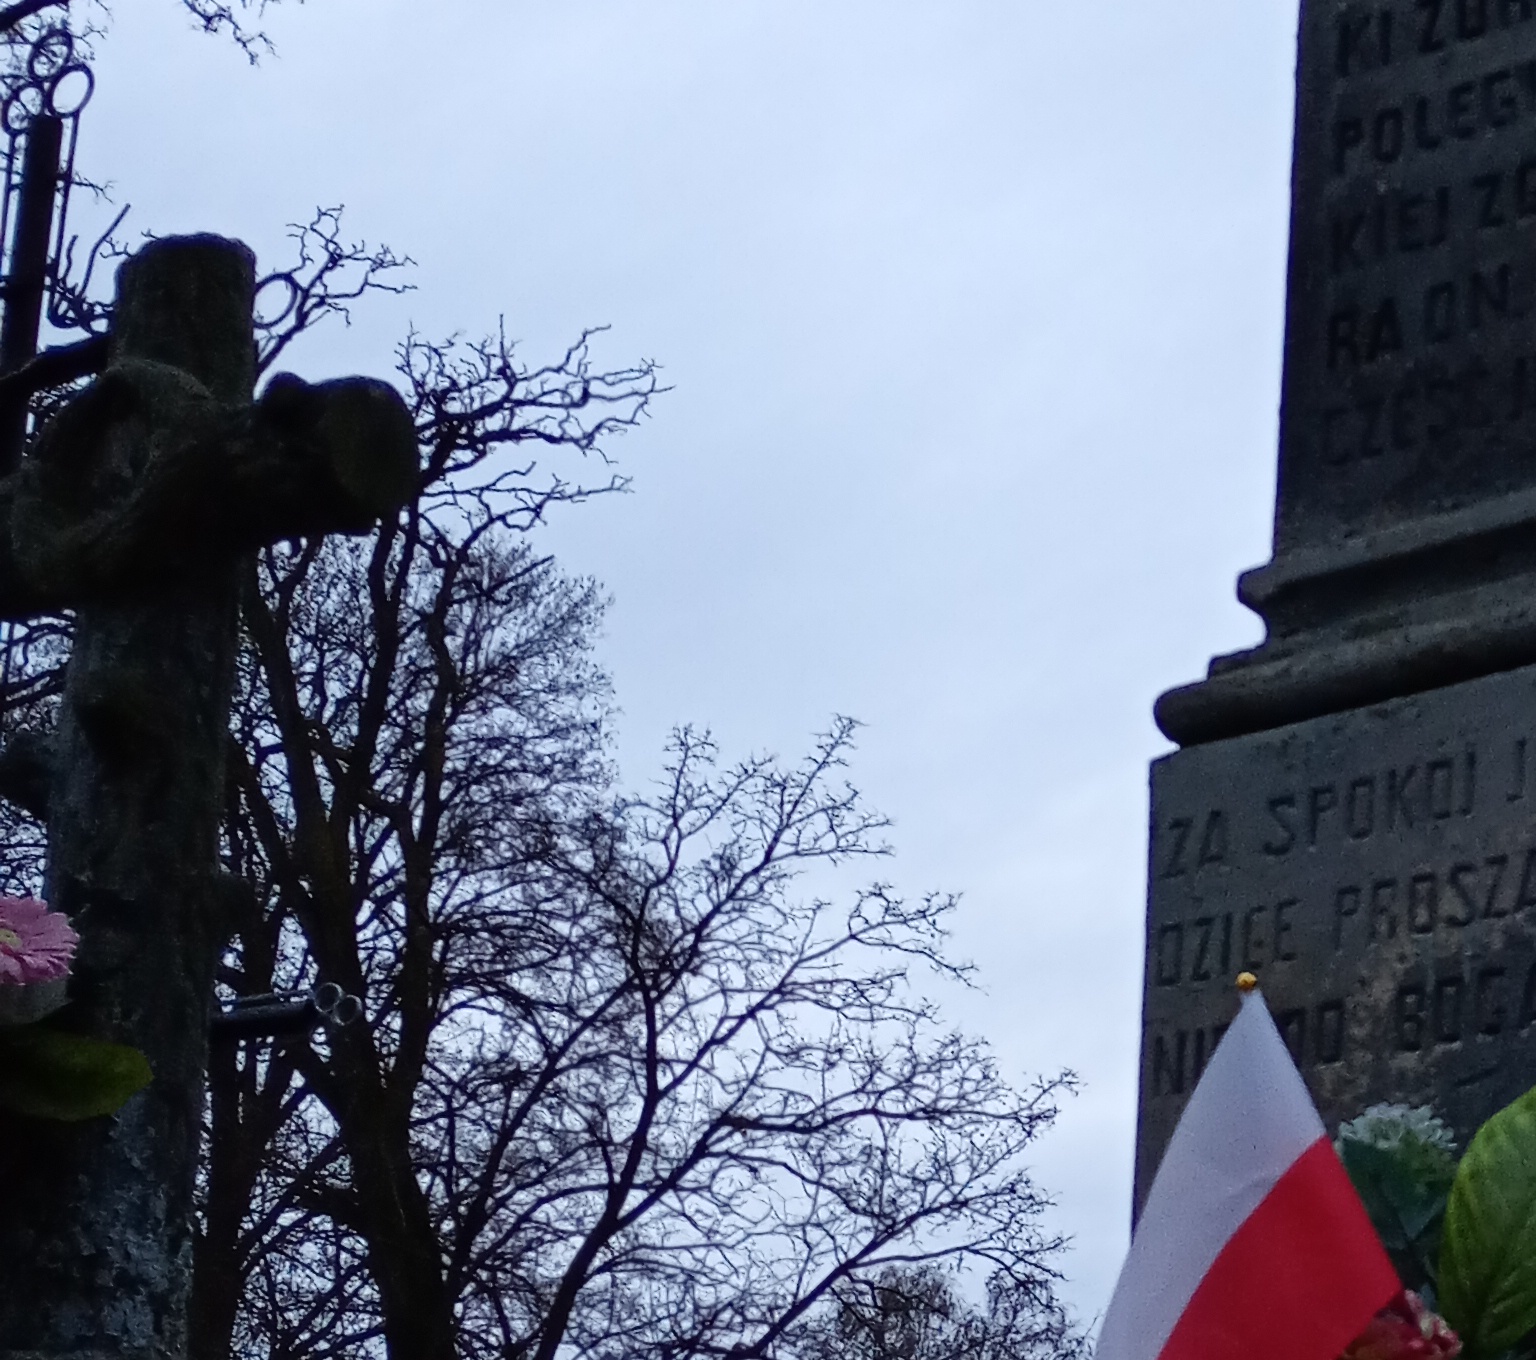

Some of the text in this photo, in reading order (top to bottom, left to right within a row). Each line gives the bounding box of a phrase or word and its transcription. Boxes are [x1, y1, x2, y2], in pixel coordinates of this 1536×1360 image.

[1334, 8, 1393, 77] KI
[1329, 186, 1449, 276] KIEJ
[1326, 296, 1403, 371] RA
[1159, 809, 1228, 879] ZA
